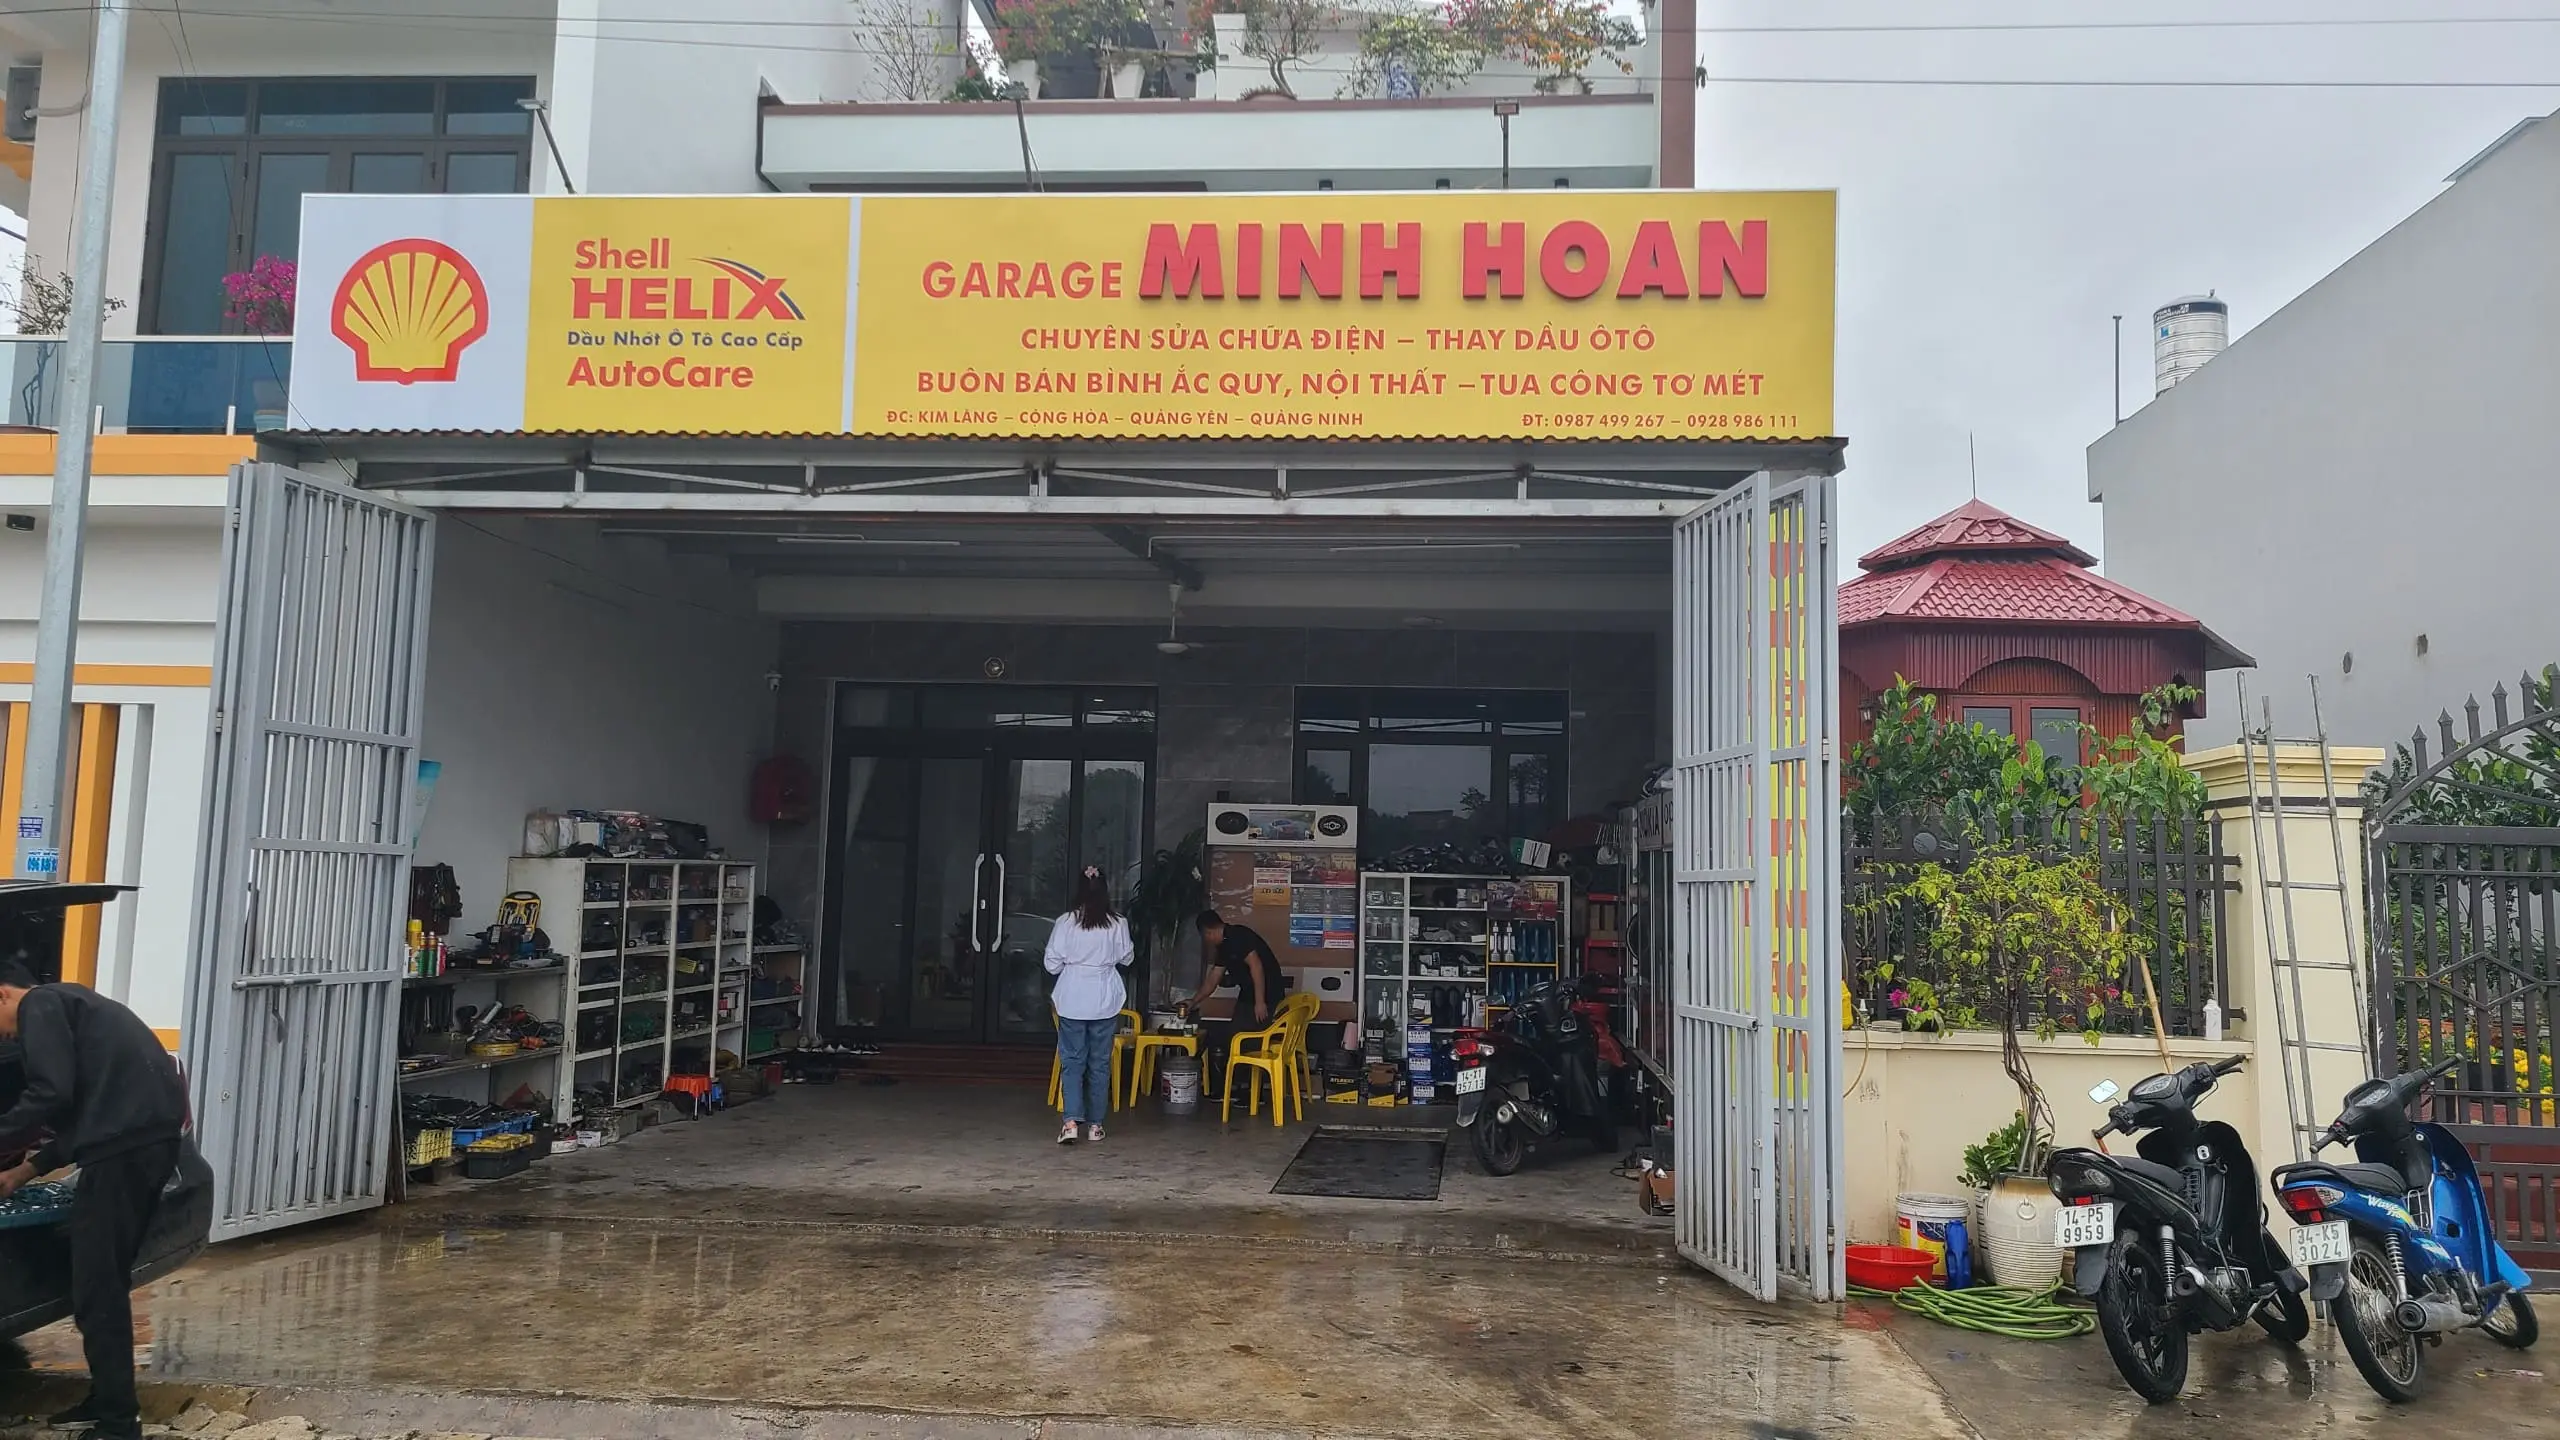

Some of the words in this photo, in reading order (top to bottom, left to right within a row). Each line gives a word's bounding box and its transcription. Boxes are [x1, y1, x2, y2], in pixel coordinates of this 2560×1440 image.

[575, 237, 670, 270] Shell
[922, 260, 1123, 300] GARAGE
[1138, 222, 1423, 301] MINH
[1462, 218, 1769, 300] HOAN
[570, 266, 805, 321] HELIX
[567, 328, 606, 347] Dầu
[668, 327, 684, 347] Ô
[691, 331, 714, 347] Tô
[721, 331, 758, 347] Cao
[765, 330, 803, 351] Cấp
[1021, 324, 1141, 350] CHUYÊN
[1150, 322, 1210, 351] SỬA
[1218, 325, 1303, 351] CHỮA
[1310, 324, 1385, 355] ĐIỆN
[1426, 328, 1506, 351] THAY
[1514, 321, 1579, 351] DẦU
[1589, 324, 1655, 351] ÔTÔ
[567, 356, 754, 389] AutoCare
[917, 367, 1005, 394] BUÔN
[1015, 367, 1077, 393] BÁN
[1086, 367, 1162, 394] BÌNH
[1218, 372, 1292, 398] QUY,
[1301, 368, 1360, 400] NỘI
[1369, 366, 1447, 395] THẤT
[1550, 369, 1643, 397] CÔNG
[1652, 374, 1696, 396] TƠ
[1703, 368, 1764, 396] MÉT
[886, 410, 913, 423] ĐC:
[918, 411, 948, 423] KIM
[1018, 408, 1069, 428] CỘNG
[1130, 411, 1193, 426] QUẢNG
[1196, 412, 1228, 425] YÊN
[1250, 412, 1313, 426] QUẢNG
[1318, 413, 1363, 426] NINH
[1522, 414, 1549, 427] ĐT:
[1554, 414, 1594, 427] 0987
[1599, 414, 1629, 427] 499
[1635, 414, 1665, 428] 267
[1687, 414, 1728, 428] 0928
[1733, 414, 1763, 428] 986
[1769, 415, 1797, 428] 111
[2065, 1207, 2105, 1226] 14-P5
[2062, 1224, 2105, 1243] 9959
[2296, 1225, 2340, 1245] 34-K5
[2298, 1243, 2343, 1264] 3024
